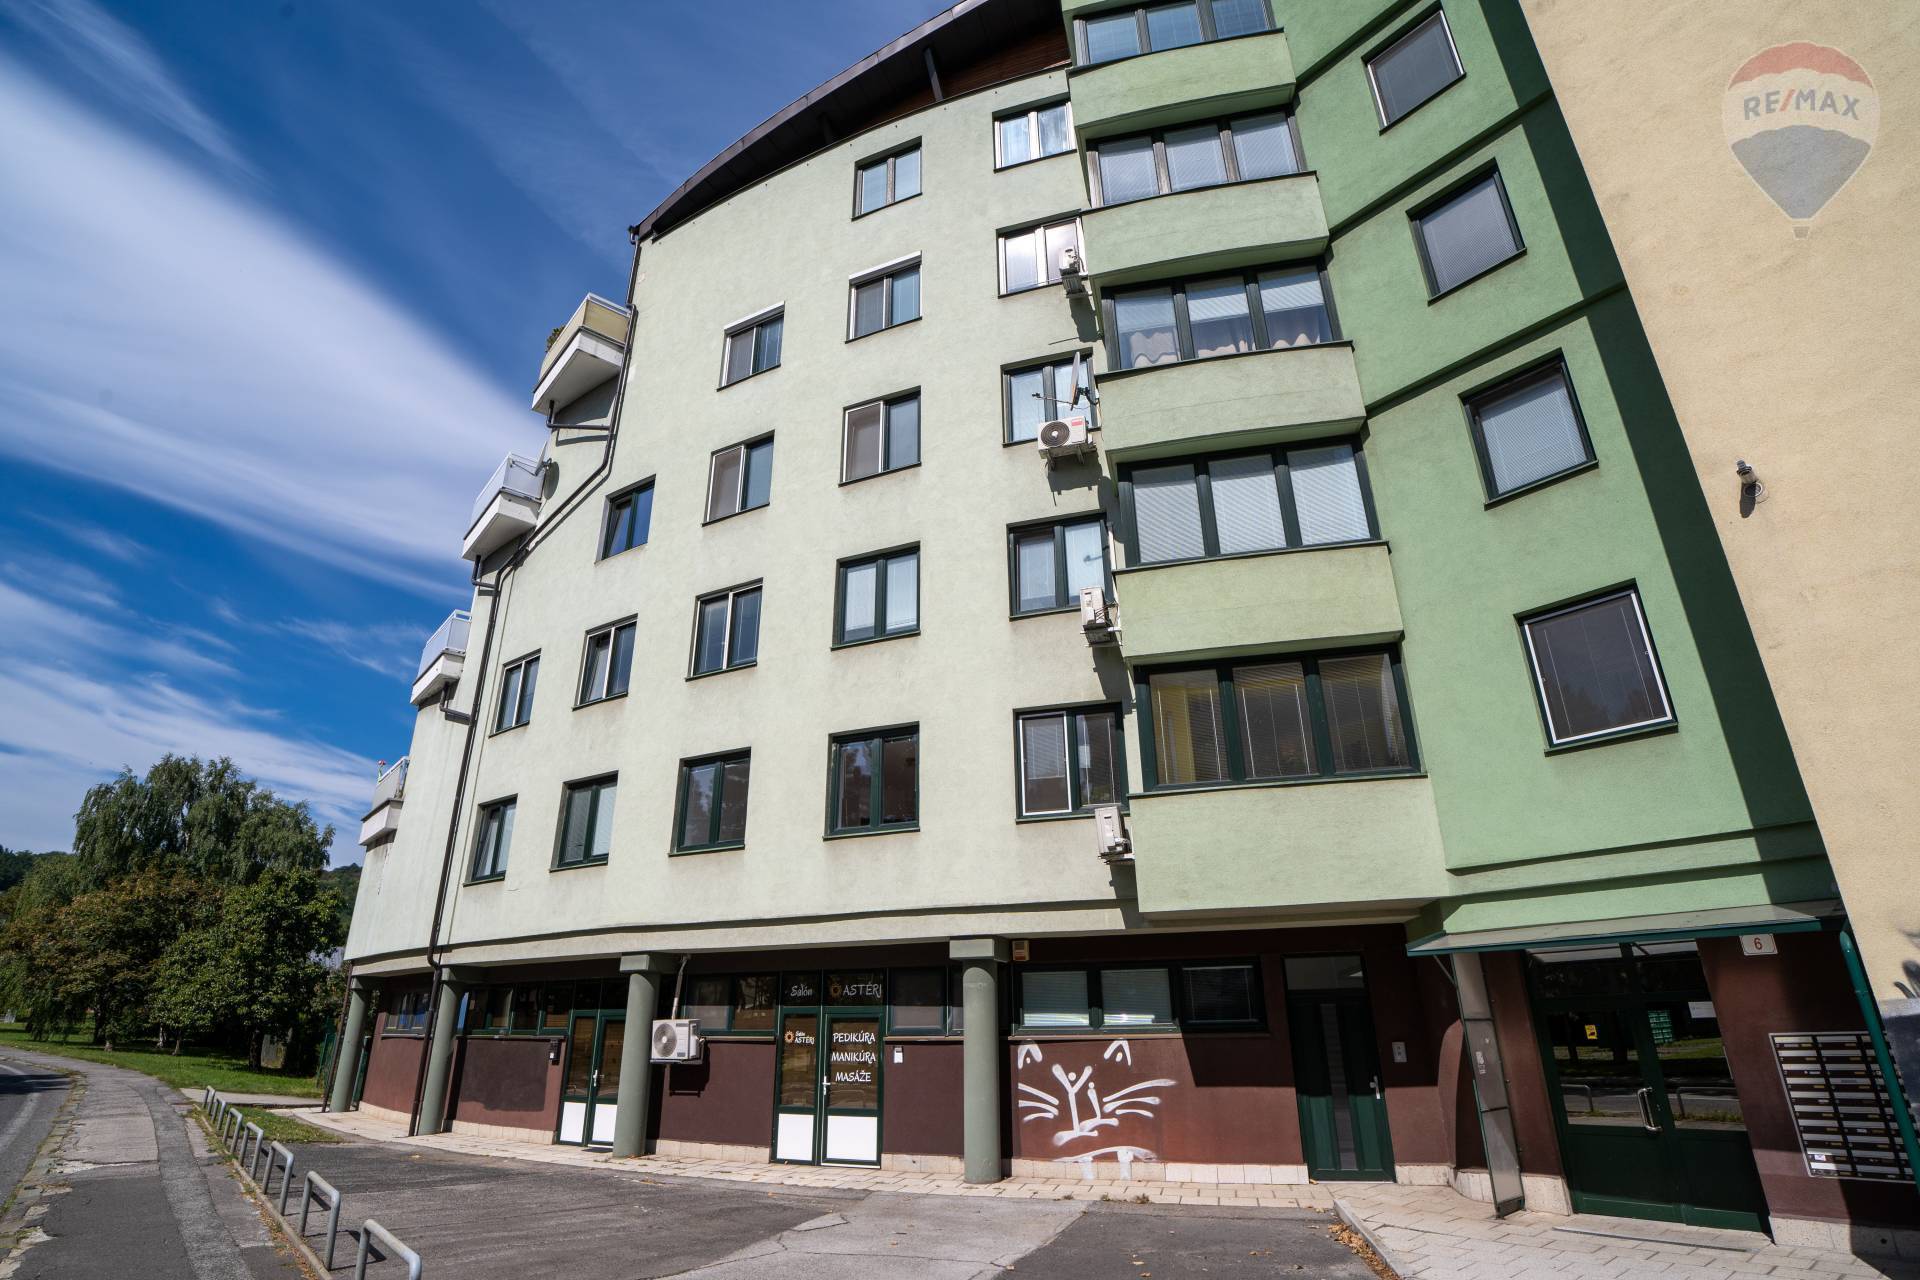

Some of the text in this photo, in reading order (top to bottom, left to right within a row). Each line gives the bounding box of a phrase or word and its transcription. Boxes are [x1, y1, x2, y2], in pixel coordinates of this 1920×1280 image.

[1754, 937, 1763, 950] 6
[832, 1030, 876, 1045] PEDIKÚRA
[831, 1050, 876, 1064] MANIKÚRA
[835, 1070, 872, 1082] MASÁŽE
